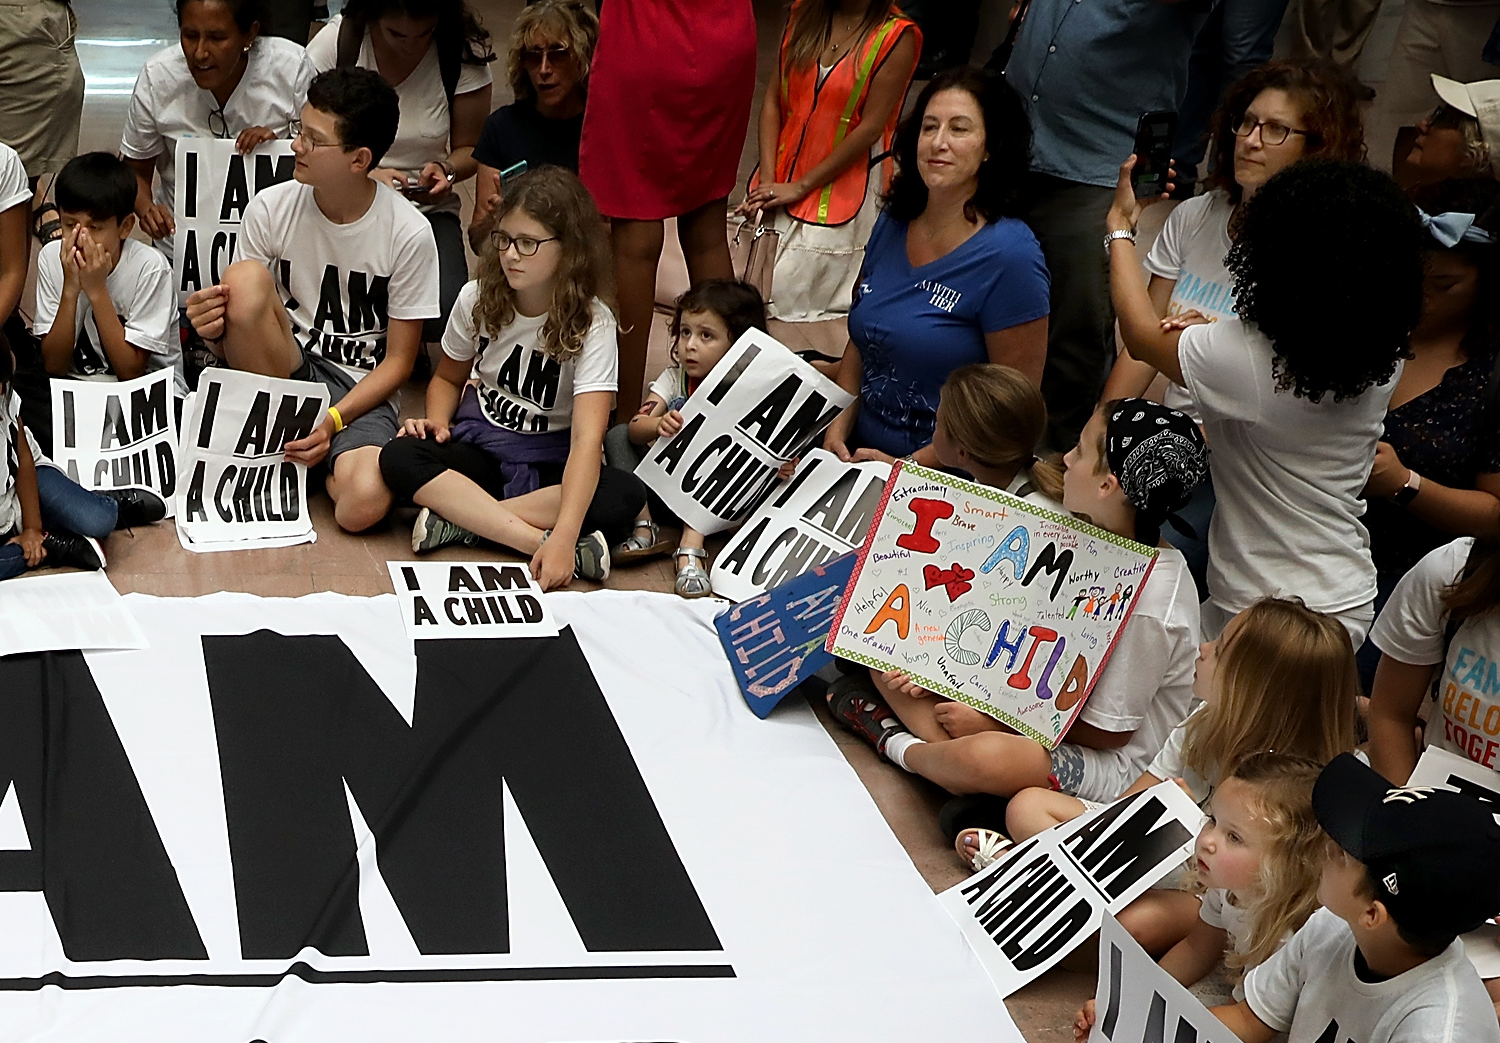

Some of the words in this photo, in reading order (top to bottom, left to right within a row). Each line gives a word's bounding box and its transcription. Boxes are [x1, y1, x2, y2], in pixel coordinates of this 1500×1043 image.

[185, 152, 198, 217] I
[181, 230, 201, 291] A
[314, 264, 391, 333] AM
[929, 294, 957, 313] HER
[932, 283, 962, 303] WITH
[497, 344, 562, 408] AM
[63, 391, 75, 448] I
[101, 378, 168, 449] AM
[707, 343, 762, 406] I
[738, 373, 843, 458] AM
[197, 382, 221, 448] I
[233, 390, 322, 455] AM
[654, 413, 706, 476] A
[187, 461, 208, 522] A
[213, 462, 300, 523] CHILD
[772, 458, 822, 508] I
[892, 483, 947, 501] Extraordinary
[952, 515, 976, 531] Brave
[963, 501, 1008, 521] Smart
[720, 517, 771, 576] A
[896, 498, 954, 553] I
[979, 525, 1074, 602] AM
[947, 534, 995, 553] Inspiring
[1043, 532, 1060, 541] every
[873, 551, 911, 563] Beautiful
[1114, 562, 1147, 578] Creative
[402, 568, 421, 591] I
[449, 567, 532, 591] AM
[996, 565, 1014, 589] Happy
[1069, 570, 1100, 585] Worthy
[415, 597, 438, 625] A
[445, 595, 543, 625] CHILD
[854, 586, 889, 614] Helpful
[916, 600, 933, 616] Nice
[989, 593, 1027, 610] Strong
[1037, 606, 1065, 620] Talented
[841, 625, 859, 639] One
[862, 635, 873, 645] of
[923, 624, 940, 632] new
[729, 594, 800, 699] CHILD
[864, 583, 911, 640] A
[944, 608, 1090, 712] CHILD
[902, 651, 930, 666] Young
[937, 656, 965, 690] Unafraid
[969, 675, 993, 701] Caring
[1017, 701, 1044, 716] Awesome
[961, 839, 1040, 905] A
[975, 853, 1092, 971] CHILD
[1102, 941, 1122, 1041] I
